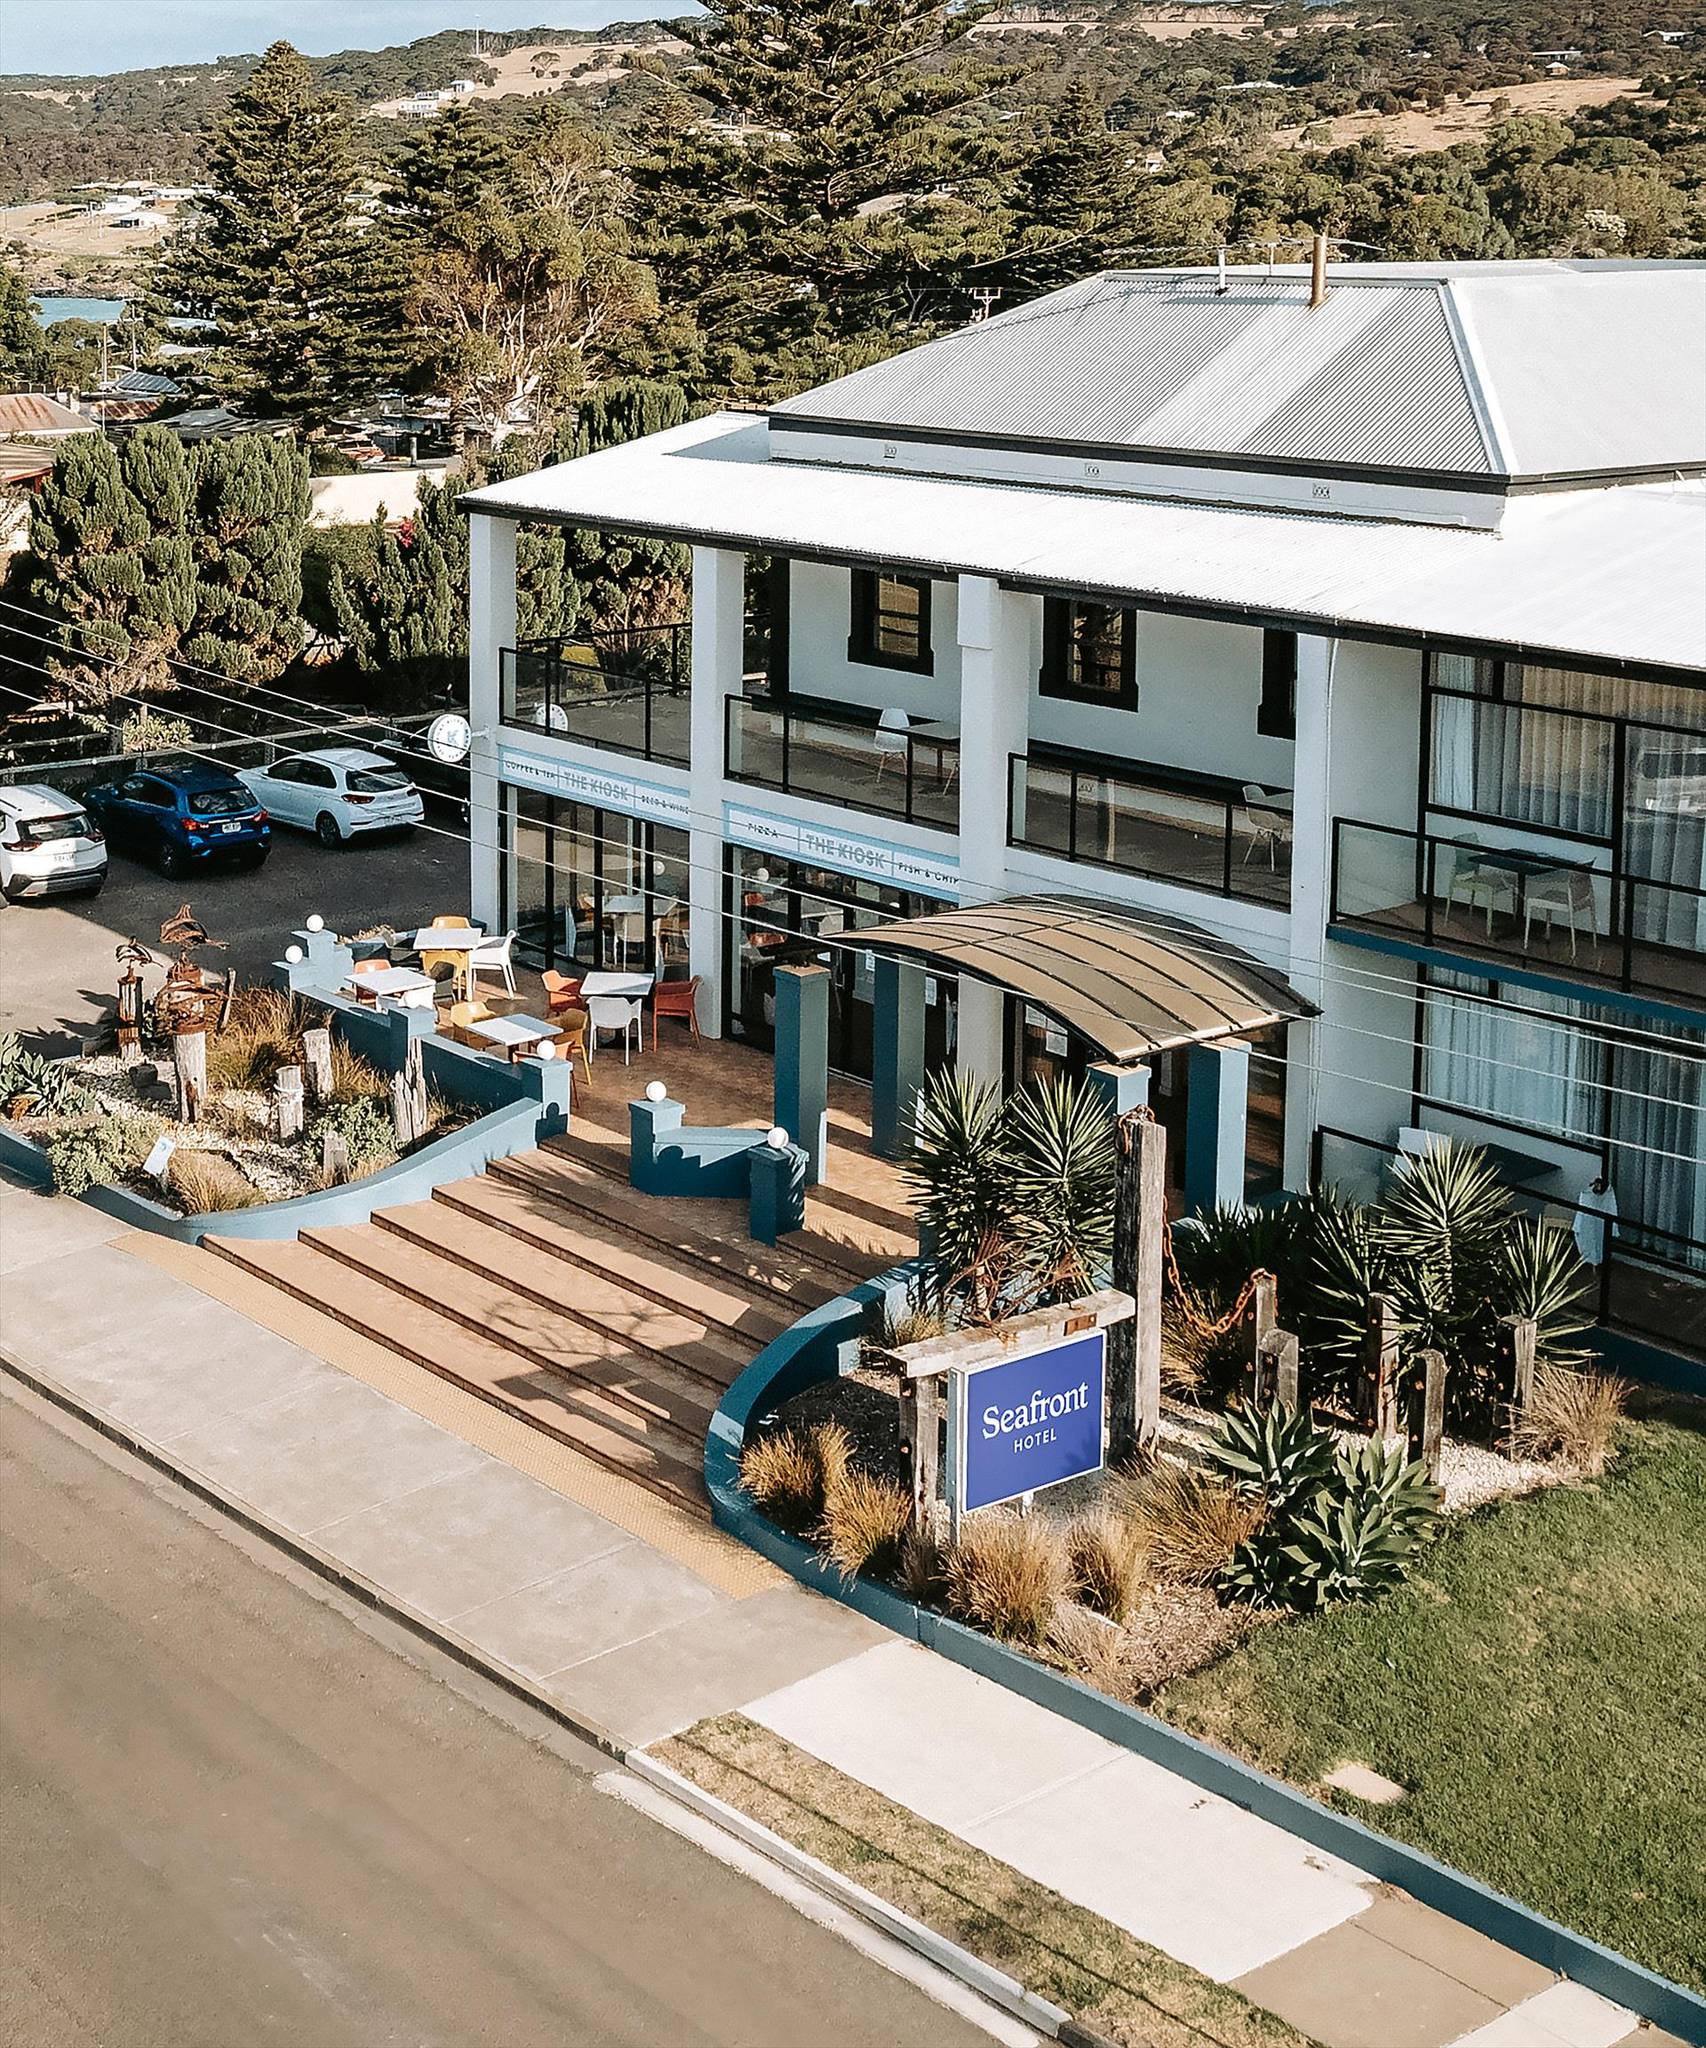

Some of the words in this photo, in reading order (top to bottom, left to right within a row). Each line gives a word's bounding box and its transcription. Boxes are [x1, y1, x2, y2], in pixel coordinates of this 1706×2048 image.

[505, 760, 533, 774] COFFEE
[563, 771, 588, 790] THE
[590, 777, 629, 802] KIOSK
[748, 822, 778, 838] PIZZA
[806, 833, 834, 856] THE
[838, 842, 886, 870] KIOSK
[898, 861, 921, 875] FISH
[934, 872, 960, 885] CHIP
[982, 1382, 1088, 1439] Seafront
[1013, 1427, 1057, 1454] HOTEL
